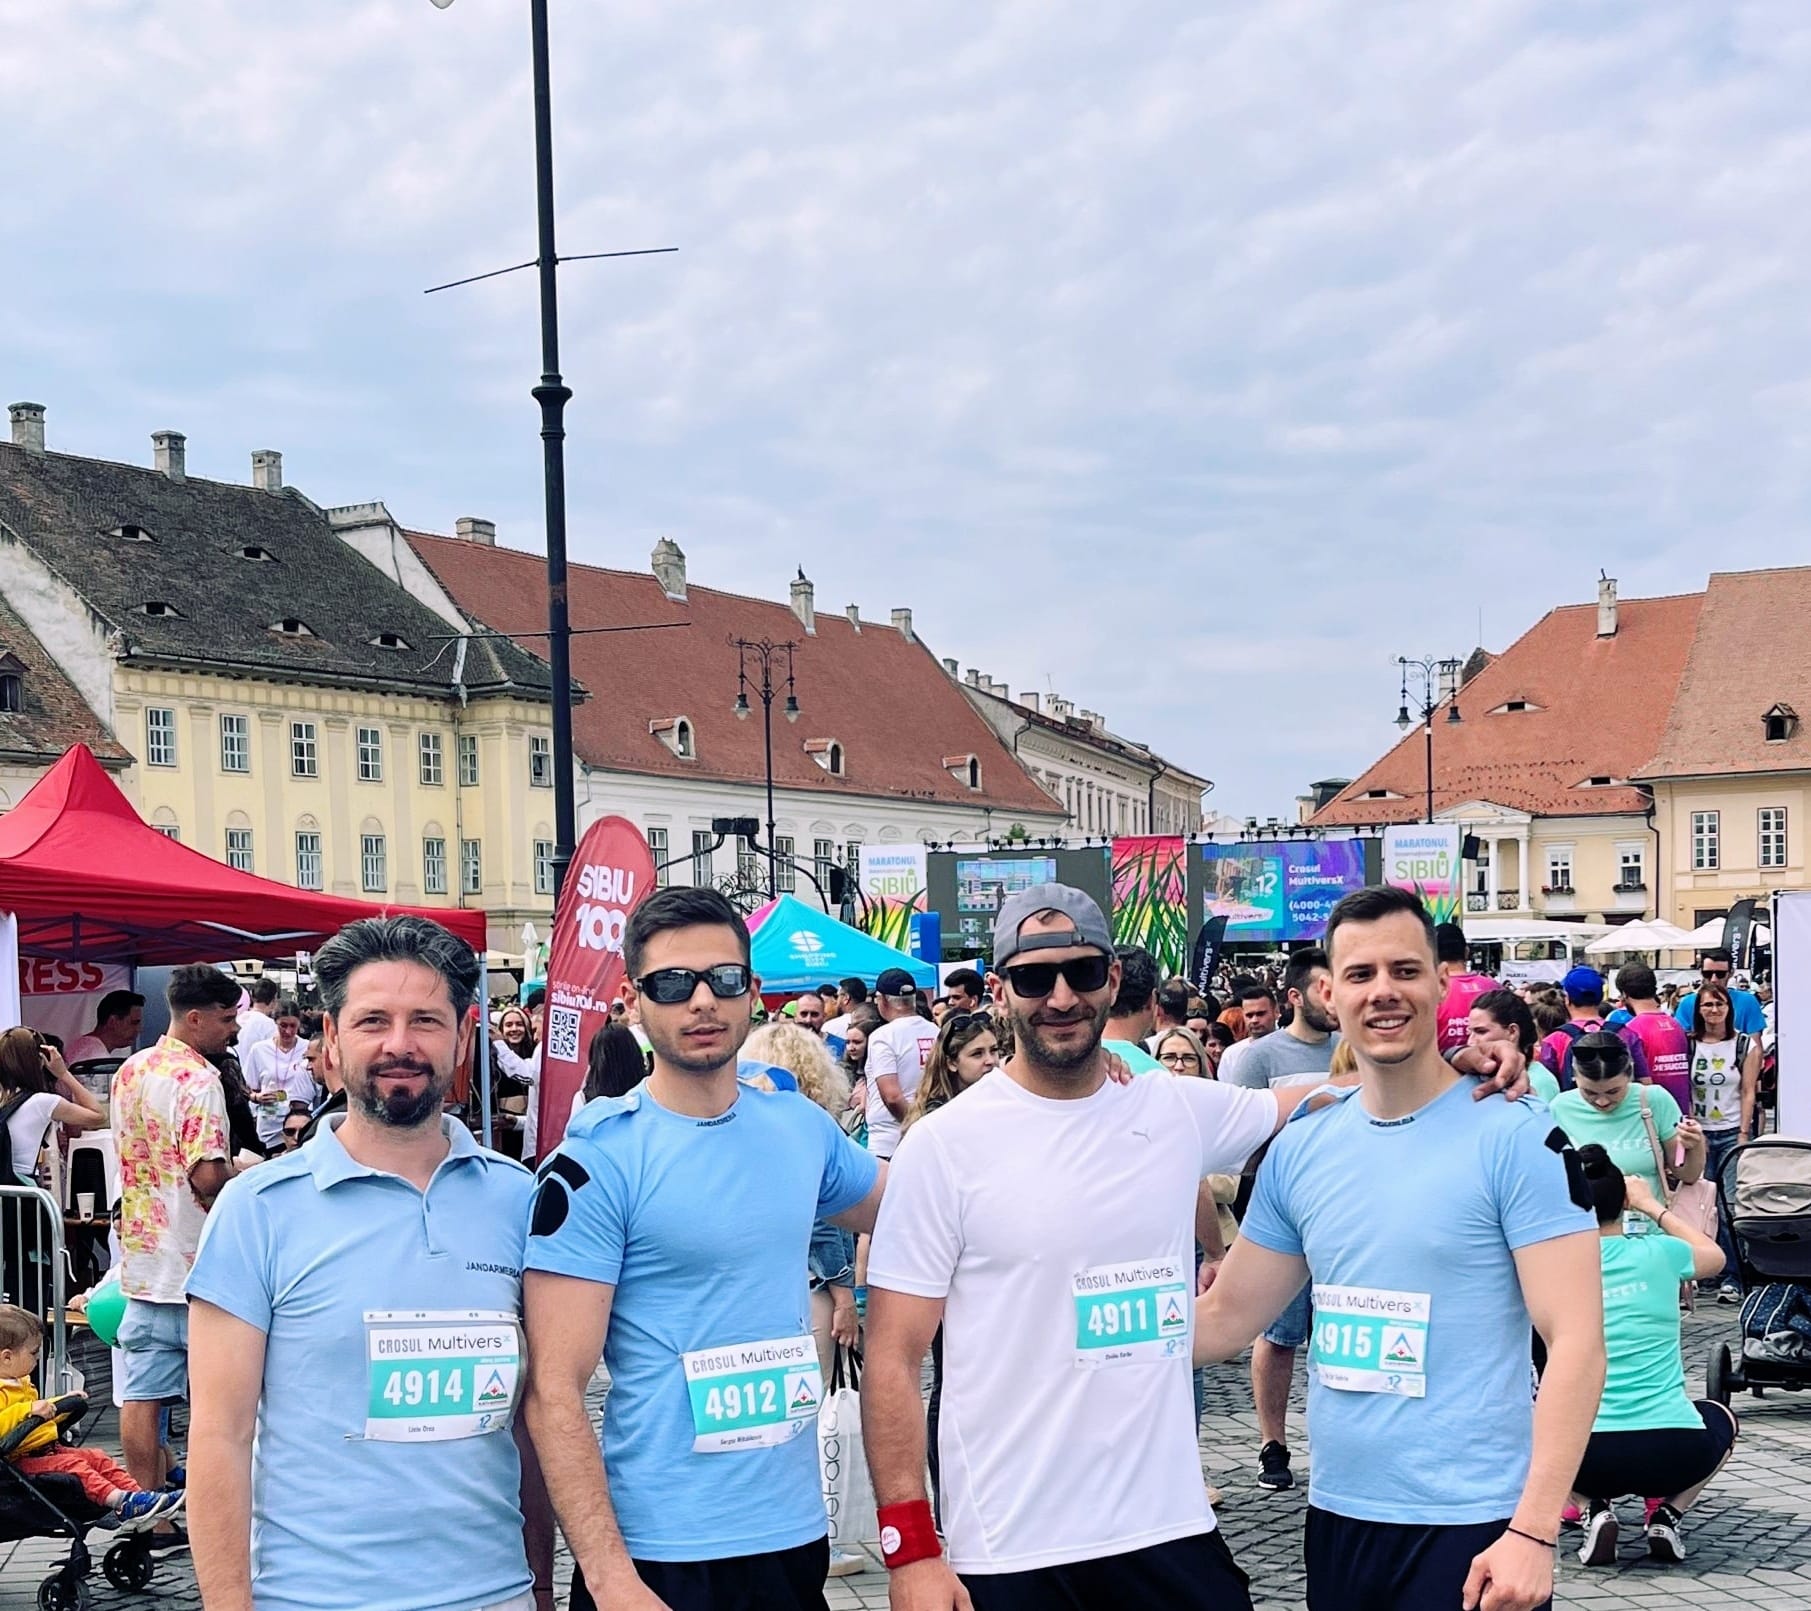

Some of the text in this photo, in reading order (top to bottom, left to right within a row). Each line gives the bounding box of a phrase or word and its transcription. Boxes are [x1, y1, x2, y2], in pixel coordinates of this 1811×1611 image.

[1394, 838, 1449, 848] MARATONUL
[868, 856, 917, 866] MARATONUL
[1288, 864, 1321, 874] Crosul
[1395, 859, 1449, 880] SIBIU
[576, 864, 634, 904] SIBIU
[869, 876, 919, 896] SIBIU
[1288, 875, 1344, 886] MultiversX
[1448, 1027, 1465, 1037] DE
[465, 1261, 521, 1278] JANDARMERIA
[1088, 1298, 1147, 1337] 4911
[378, 1337, 423, 1354] CROSUL
[692, 1354, 737, 1374] CROSUL
[383, 1368, 464, 1406] 4914
[704, 1379, 777, 1421] 4912
[479, 1414, 492, 1429] 12
